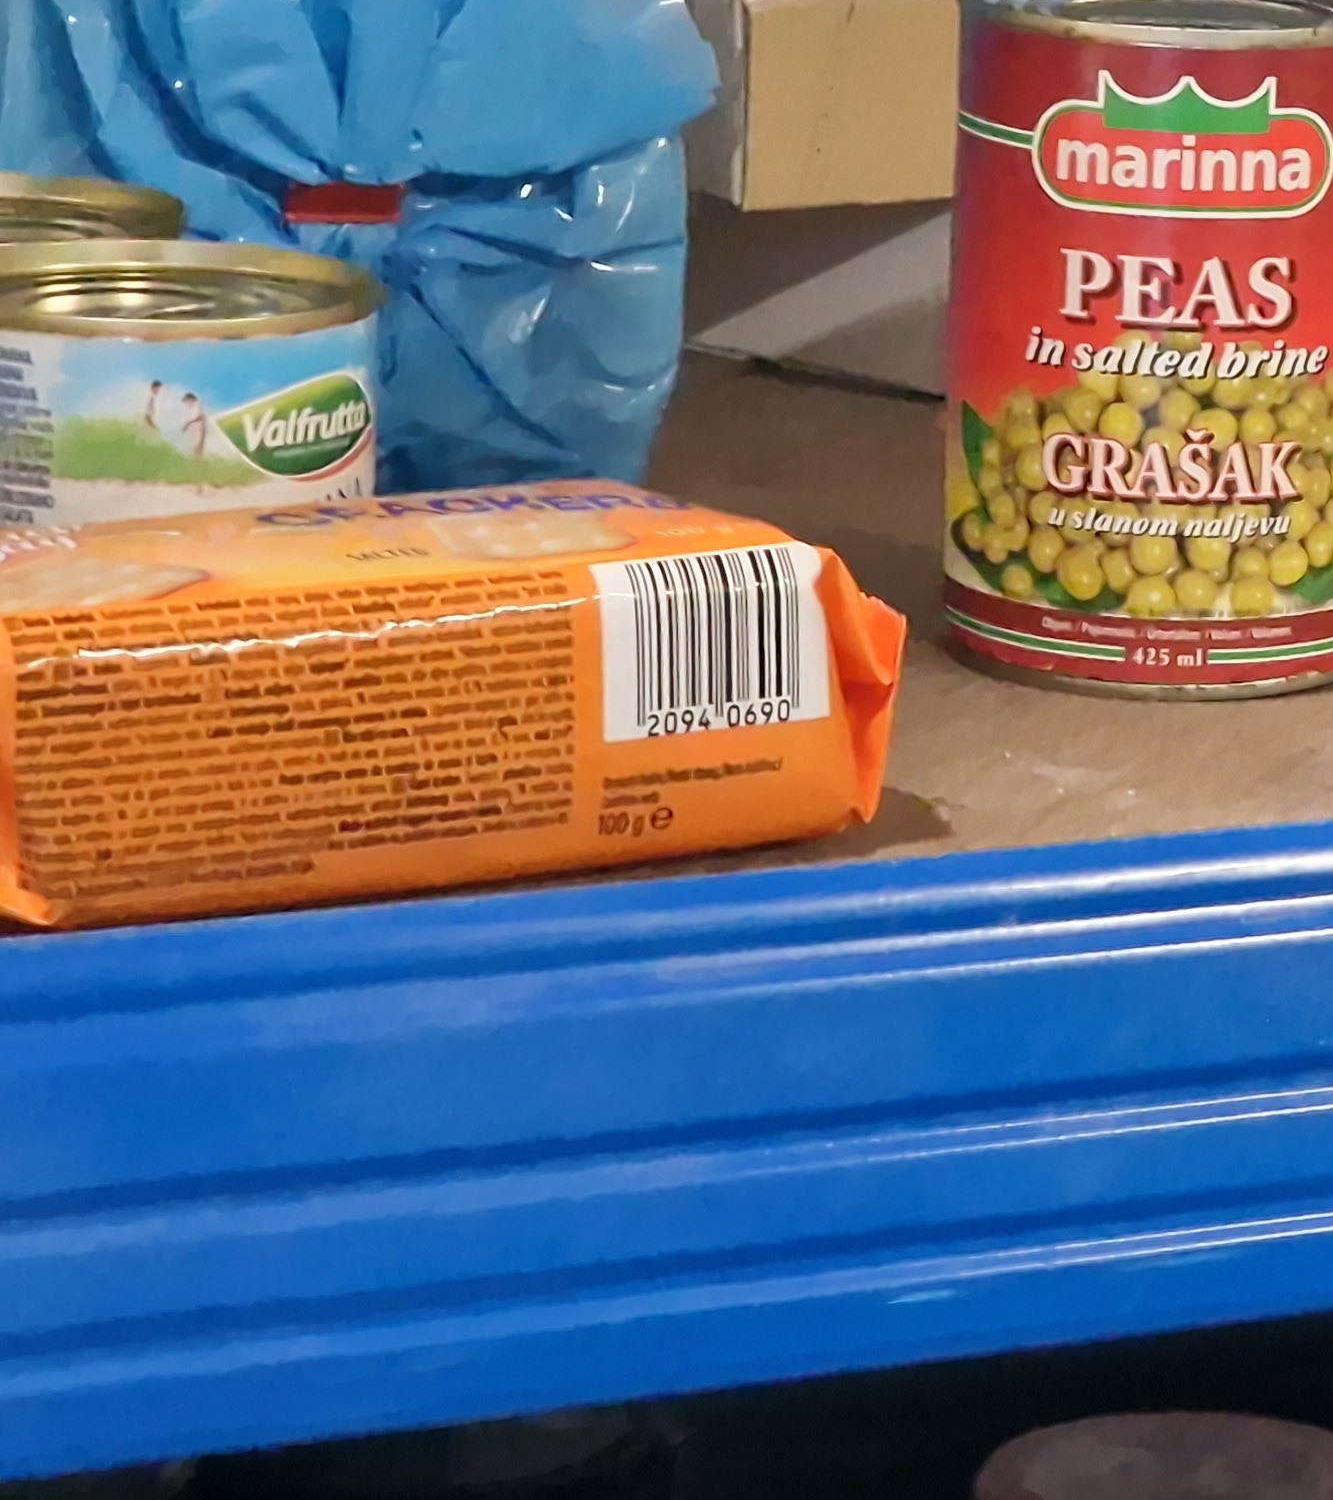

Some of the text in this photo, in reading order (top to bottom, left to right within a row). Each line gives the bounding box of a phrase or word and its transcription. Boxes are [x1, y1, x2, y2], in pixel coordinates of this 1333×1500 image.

[1055, 134, 1312, 192] marinna
[1058, 247, 1296, 328] PEAS
[1025, 326, 1329, 380] in salted brine
[242, 399, 367, 453] Valfrutta
[1041, 427, 1303, 503] GRAŠAK
[1047, 507, 1292, 544] u slanom naljevu
[1132, 648, 1203, 668] 425 ml
[647, 698, 790, 738] 2094 0690
[599, 811, 630, 836] 100
